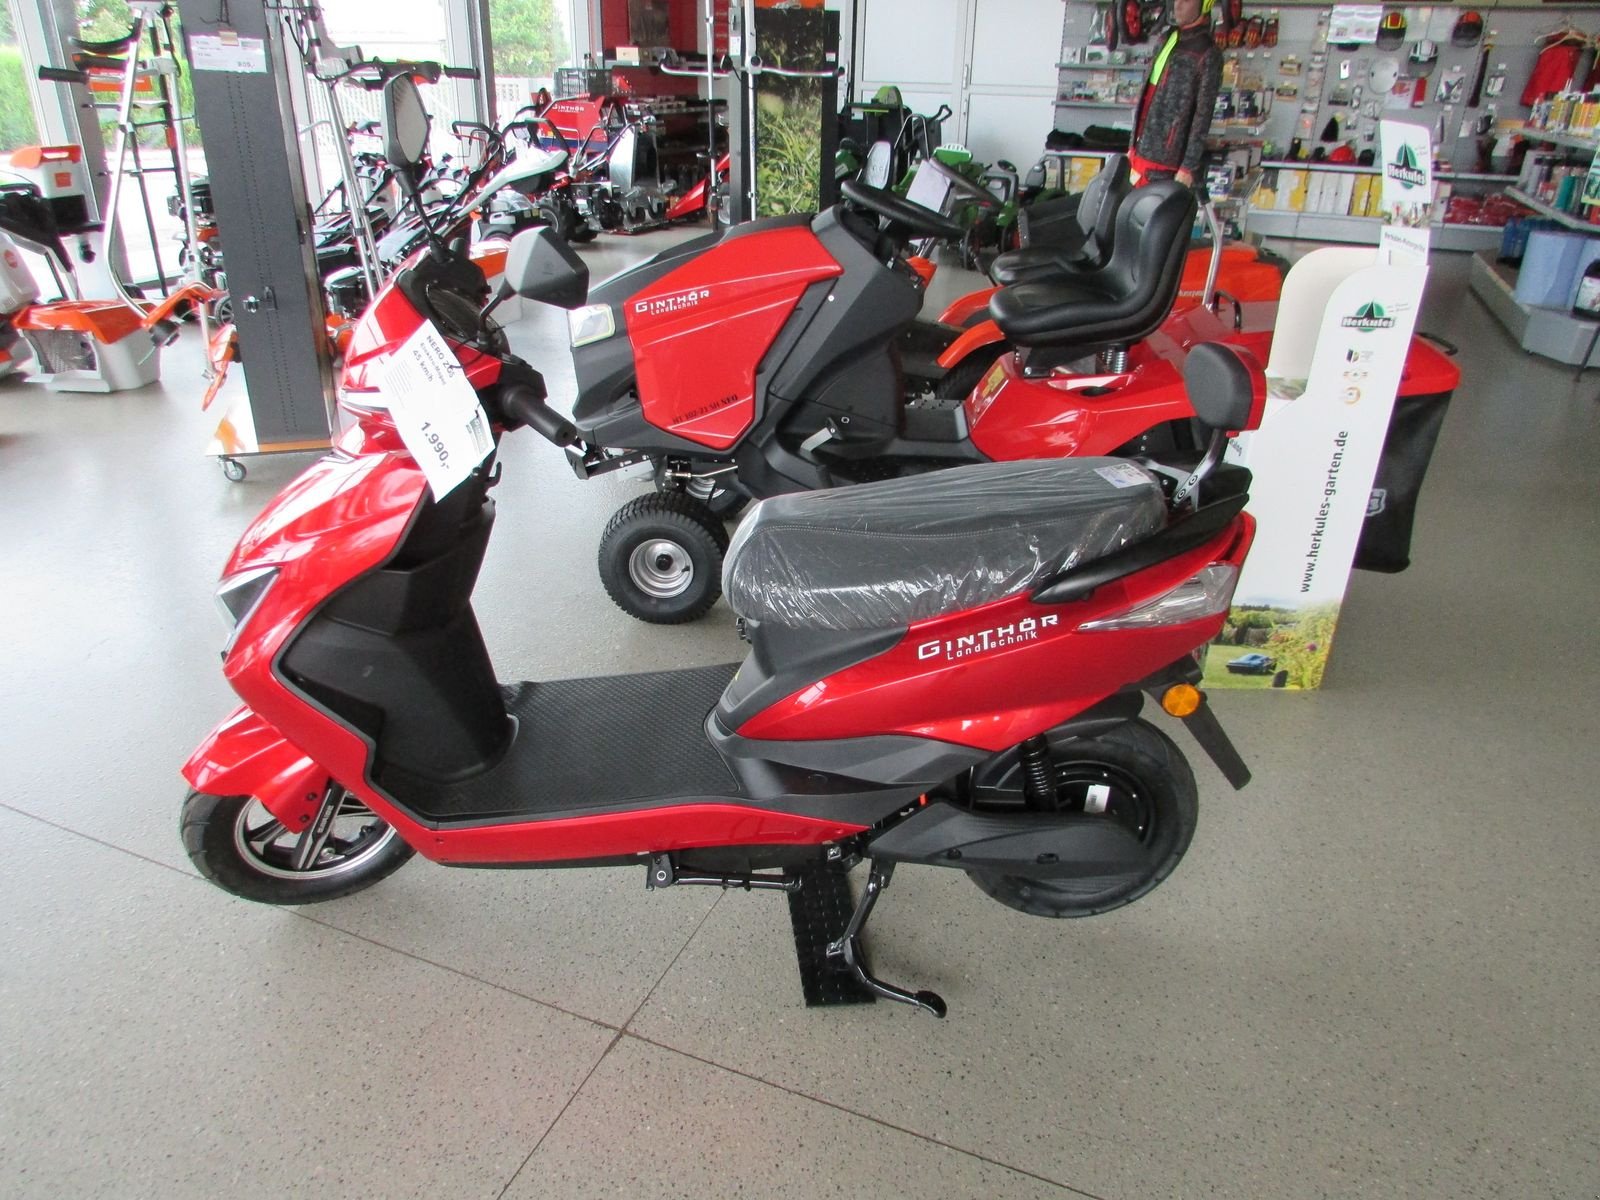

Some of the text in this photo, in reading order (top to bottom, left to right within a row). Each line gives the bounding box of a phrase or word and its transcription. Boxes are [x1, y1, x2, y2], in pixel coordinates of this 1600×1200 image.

[1387, 163, 1426, 185] Herkules
[635, 290, 710, 313] GINTHÖR
[1342, 317, 1395, 328] Herkules
[412, 349, 422, 361] 45
[426, 335, 444, 360] NERO
[421, 421, 450, 470] 1.990,-
[1300, 431, 1349, 593] www.herkules-garten.de
[918, 614, 1058, 660] GINTHÖR
